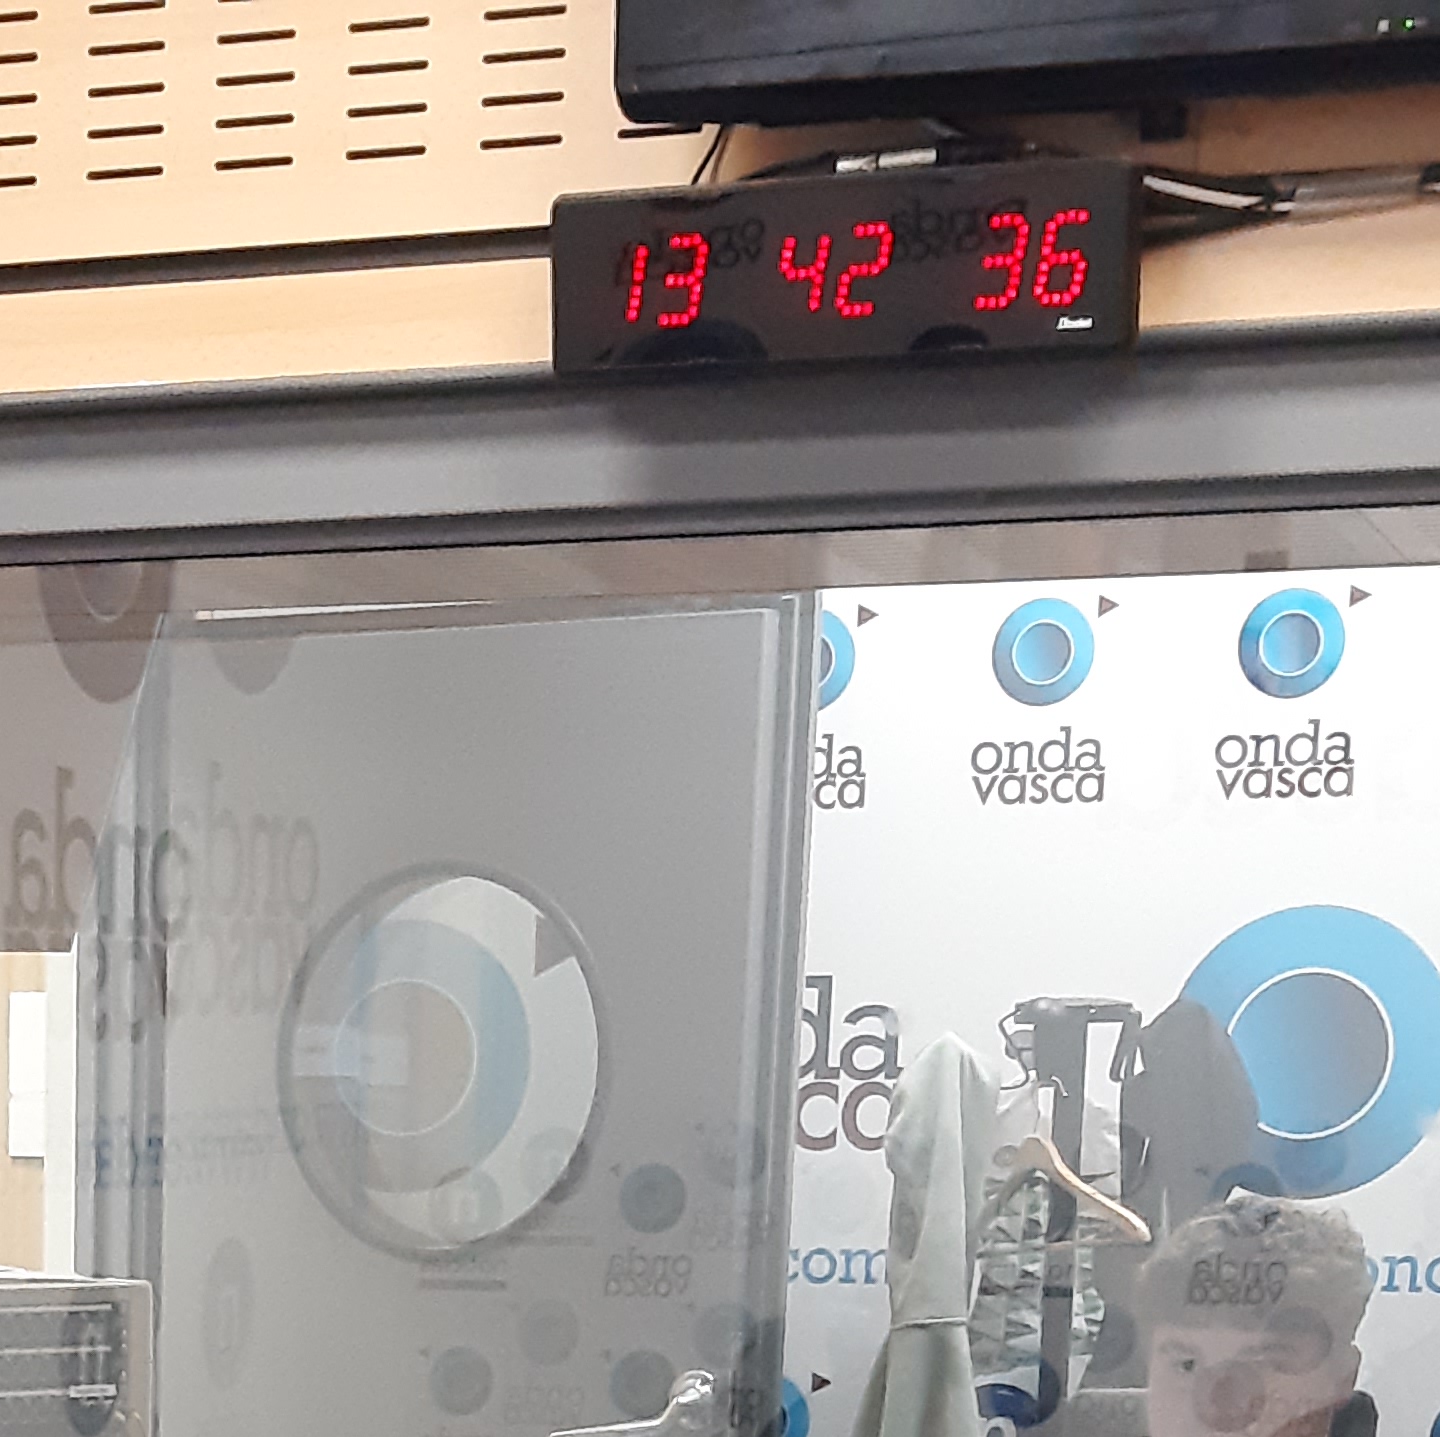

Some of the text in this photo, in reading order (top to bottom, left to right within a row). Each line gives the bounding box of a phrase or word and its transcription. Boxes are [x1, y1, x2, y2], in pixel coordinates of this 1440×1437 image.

[623, 231, 709, 329] 13
[778, 220, 895, 320] 42
[972, 207, 1091, 311] 36
[814, 733, 866, 779] da
[971, 726, 1106, 774] onda
[1215, 718, 1355, 768] onda
[971, 772, 1106, 805] vasca
[1215, 766, 1355, 800] vasca
[800, 975, 904, 1081] da
